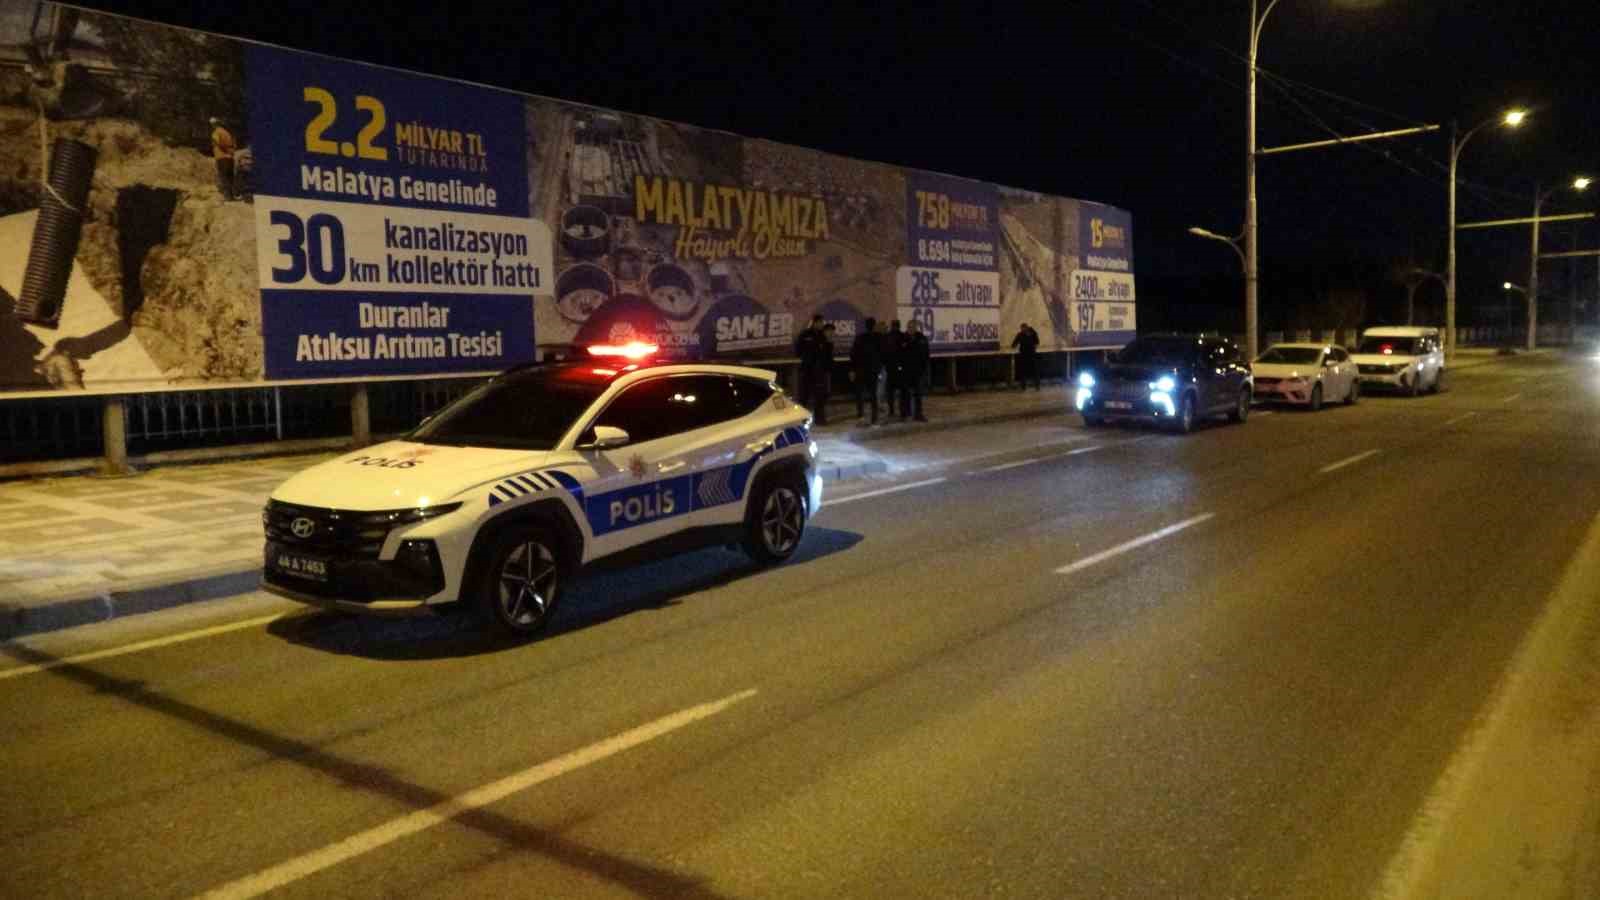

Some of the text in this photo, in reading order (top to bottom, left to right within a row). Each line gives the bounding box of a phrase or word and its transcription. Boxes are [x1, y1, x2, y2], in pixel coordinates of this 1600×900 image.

[303, 87, 388, 161] 2.2
[395, 120, 487, 156] MİLYAR TL
[396, 147, 488, 172] TUTARINDA
[301, 165, 497, 207] Malatya Genelinde
[635, 175, 829, 239] MALATYAMIZA
[269, 210, 380, 285] 30 km
[384, 218, 528, 259] kanalizasyon
[387, 254, 540, 287] kollektör hattı
[911, 270, 940, 305] 285
[359, 302, 449, 329] Duranlar
[296, 331, 502, 362] Atıksu Arıtma Tesisi
[610, 483, 674, 526] POLİS
